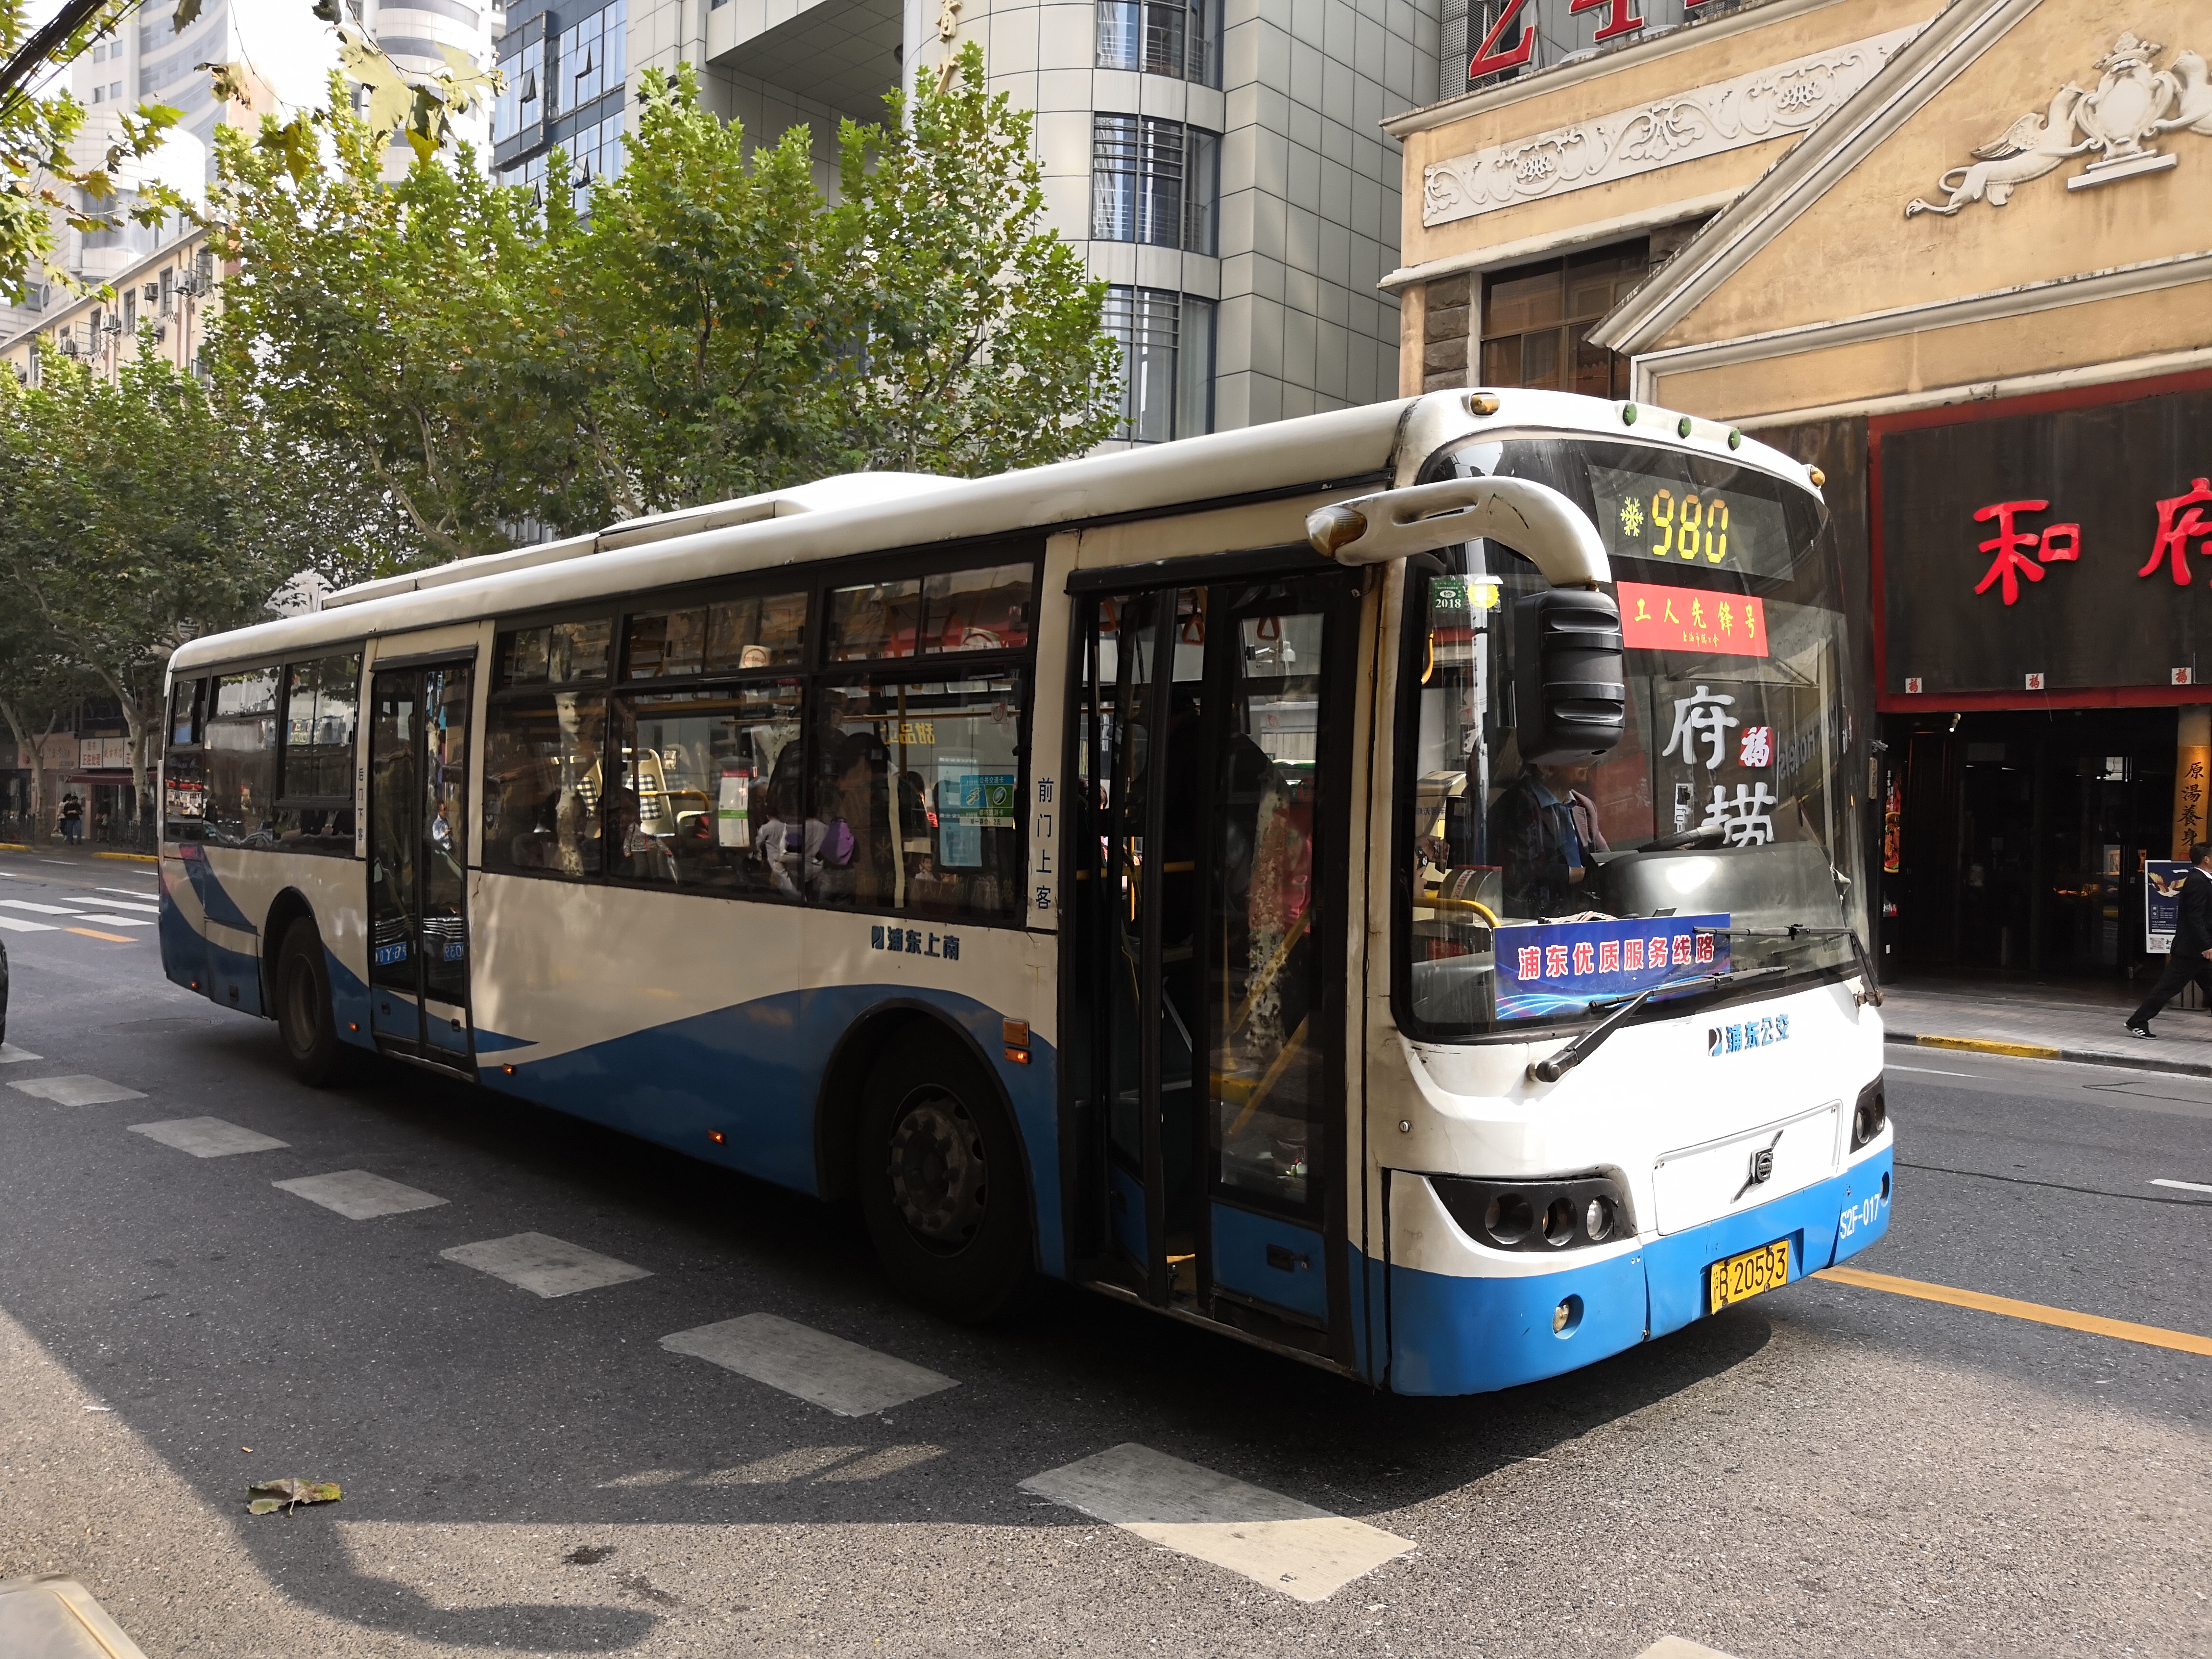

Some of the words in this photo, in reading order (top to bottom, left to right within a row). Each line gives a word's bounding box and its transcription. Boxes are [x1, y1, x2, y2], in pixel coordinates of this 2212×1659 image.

[1652, 489, 1729, 563] 980
[1435, 599, 1461, 608] 2018
[1035, 777, 1054, 909] 前门上客
[887, 926, 960, 961] 浦东上南
[1518, 933, 1714, 980] 浦东优质服务线路
[1725, 1014, 1790, 1054] 浦东公交
[1840, 1193, 1880, 1239] S2F-017
